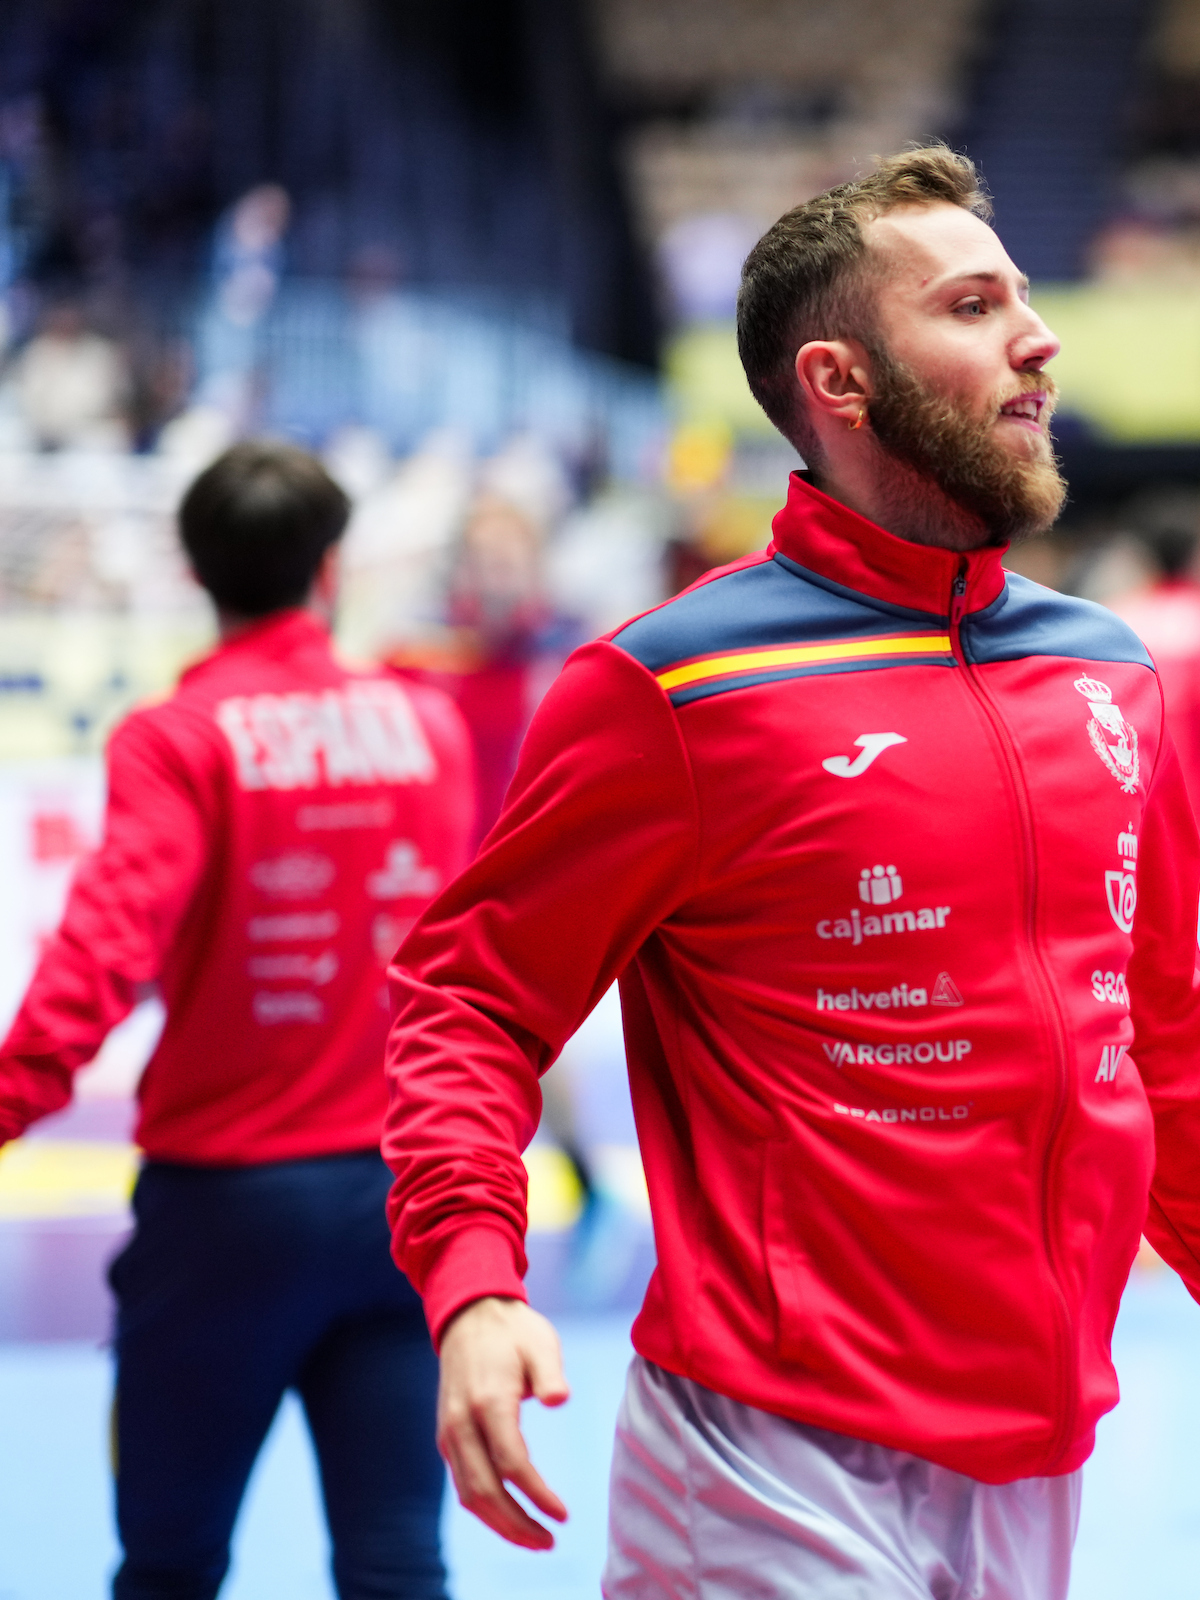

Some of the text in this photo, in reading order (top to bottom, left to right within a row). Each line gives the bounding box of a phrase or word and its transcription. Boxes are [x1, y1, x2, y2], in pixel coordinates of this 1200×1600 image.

[817, 906, 952, 946] cajamar
[816, 984, 928, 1012] helvetia
[822, 1040, 973, 1067] VARGROUP
